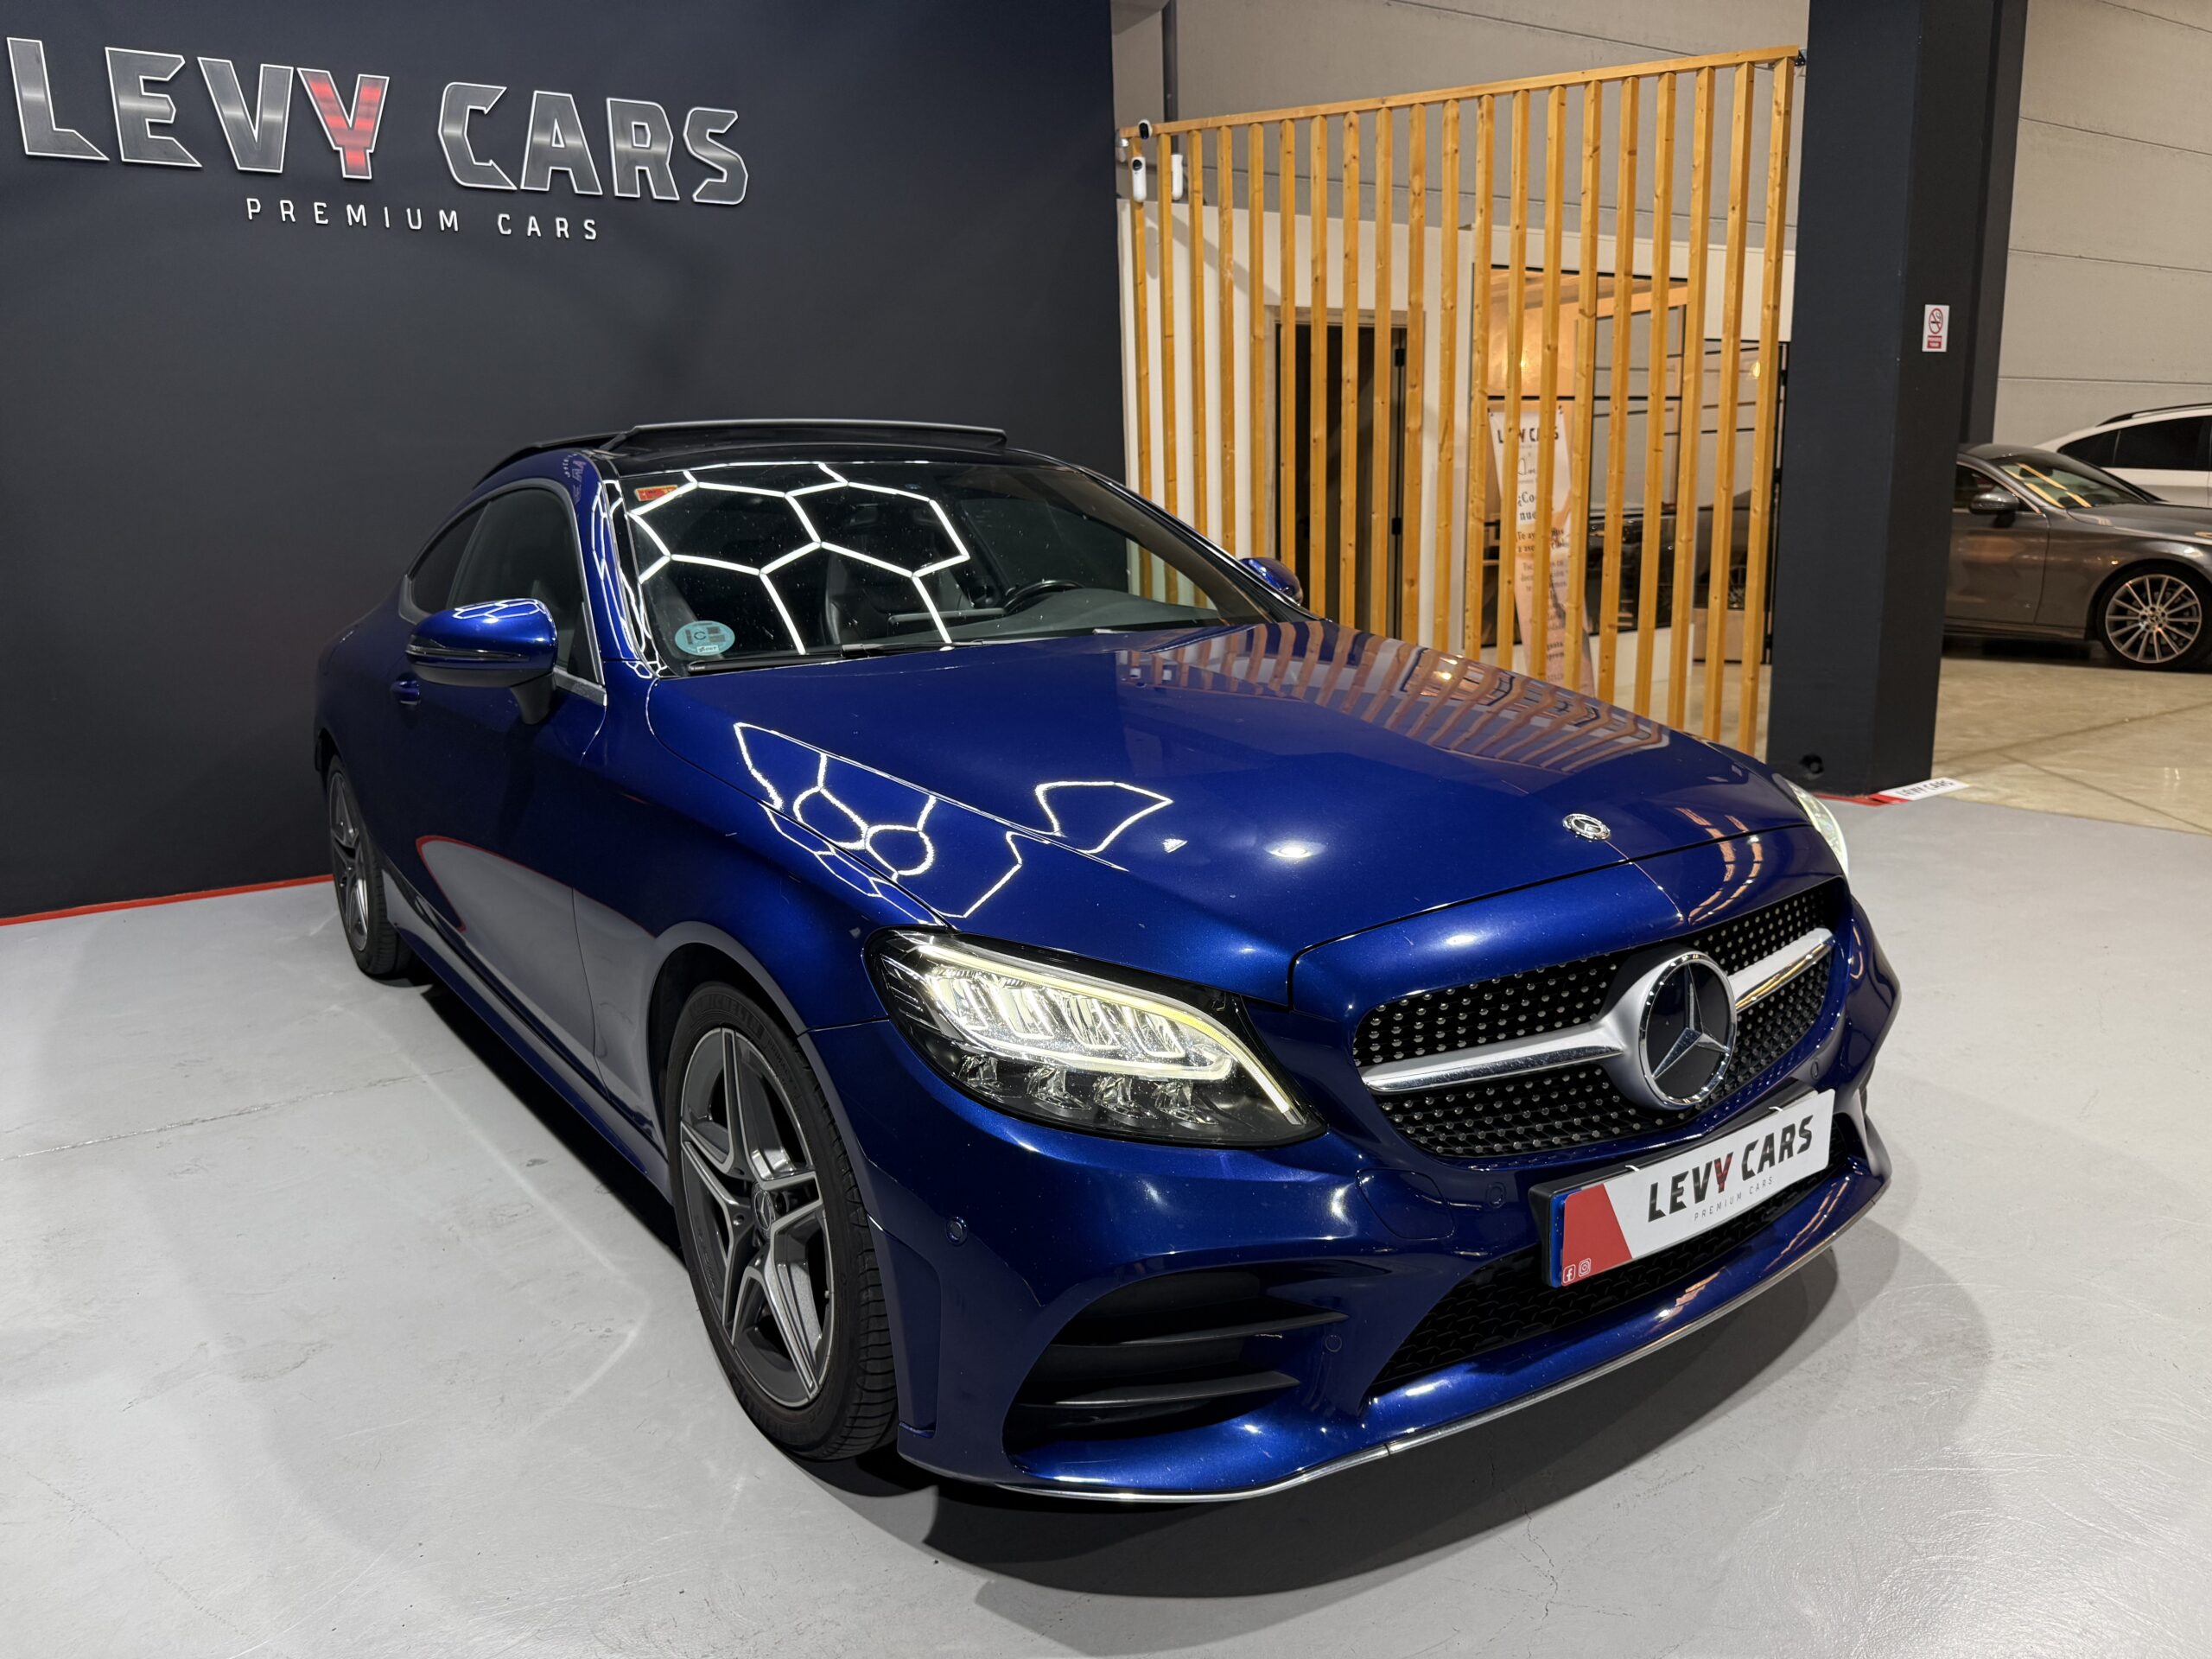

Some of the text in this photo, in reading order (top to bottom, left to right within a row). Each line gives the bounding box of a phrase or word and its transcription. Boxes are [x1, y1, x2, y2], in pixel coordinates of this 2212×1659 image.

[5, 36, 748, 206] LEVY CARS
[246, 198, 597, 241] PREMIUM CARS
[1648, 1115, 1814, 1223] LEVY CARS
[1694, 1176, 1773, 1221] PREMIUM CARS
